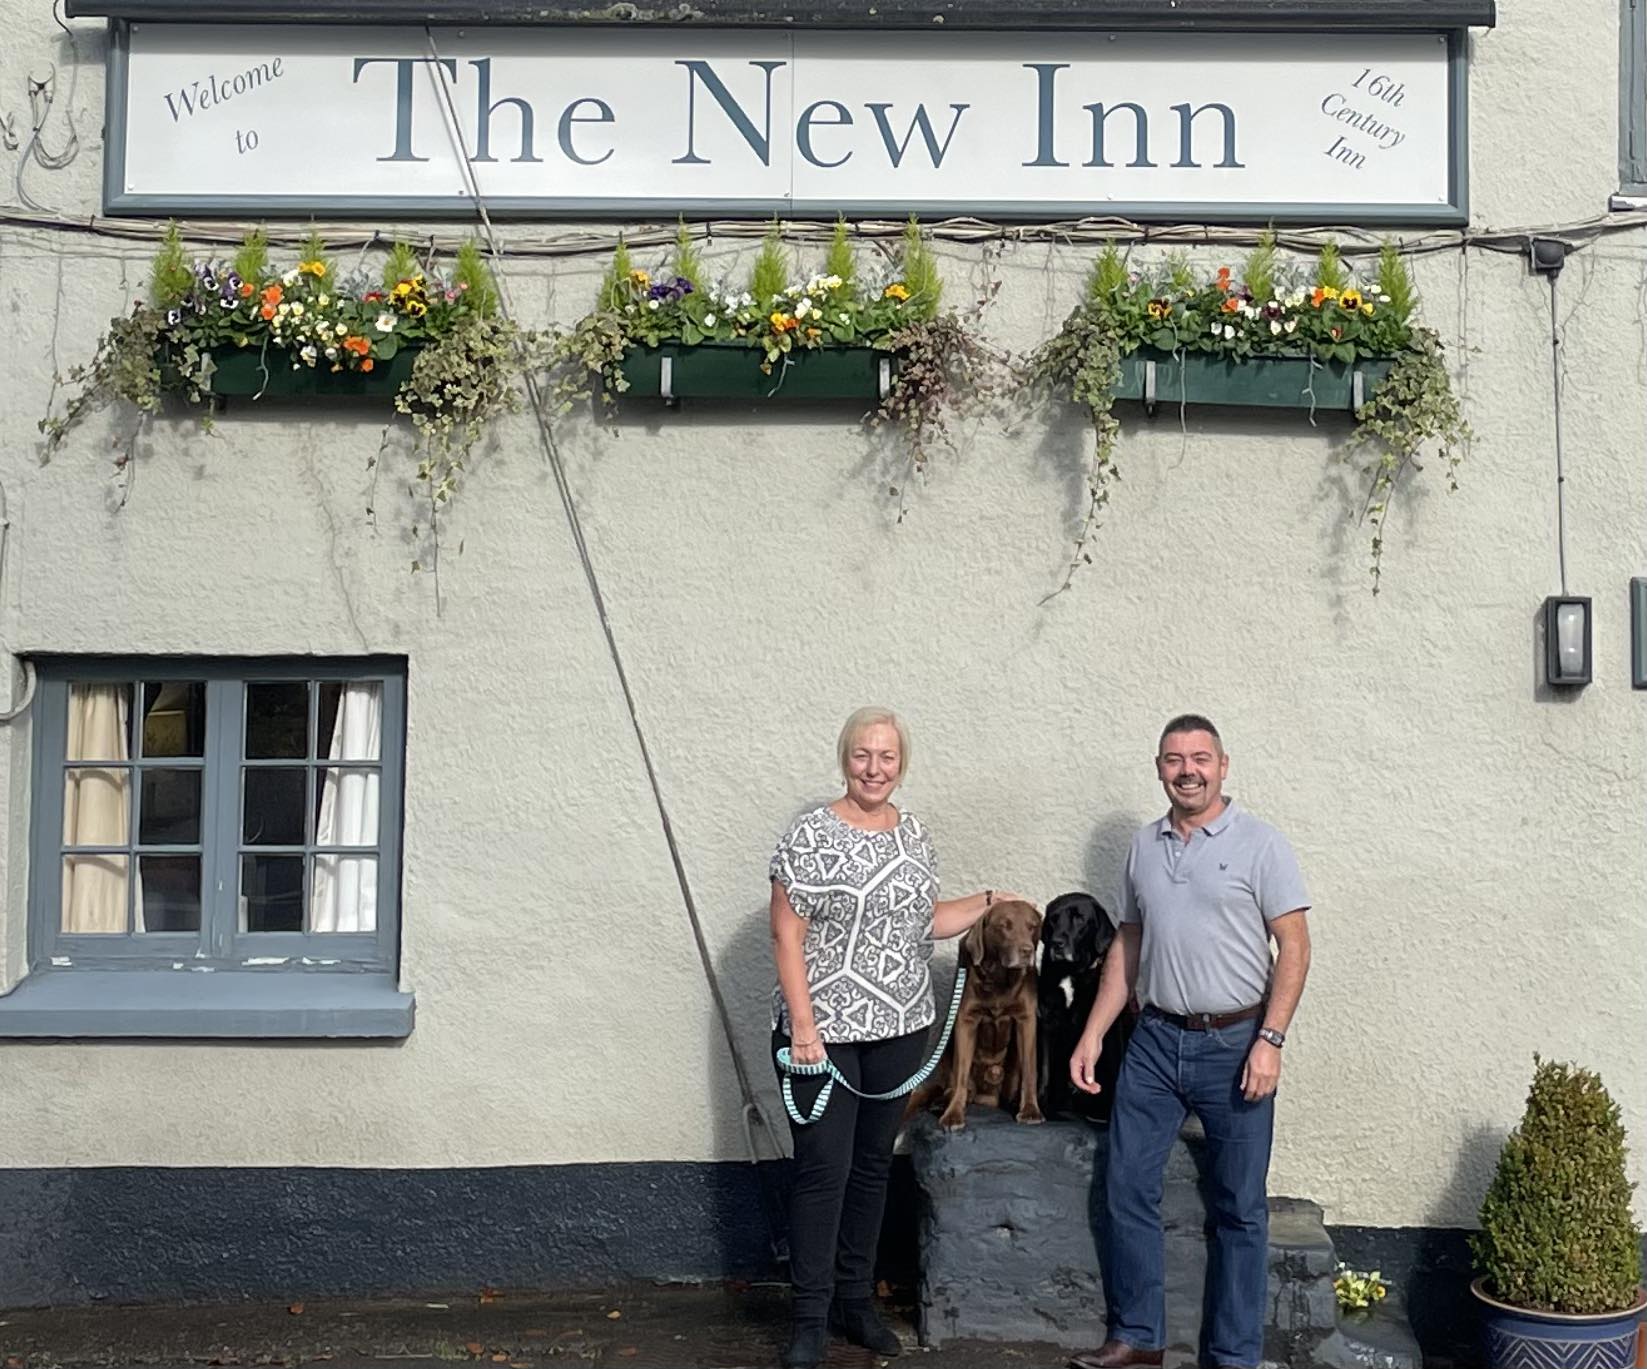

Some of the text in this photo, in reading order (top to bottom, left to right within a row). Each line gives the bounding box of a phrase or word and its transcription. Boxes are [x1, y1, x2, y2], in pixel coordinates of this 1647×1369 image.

[164, 58, 285, 123] Welcome
[353, 56, 1246, 169] The New Inn
[1352, 68, 1406, 108] 16th
[235, 129, 259, 155] to
[1321, 92, 1406, 150] Century
[1324, 135, 1367, 170] Inn
